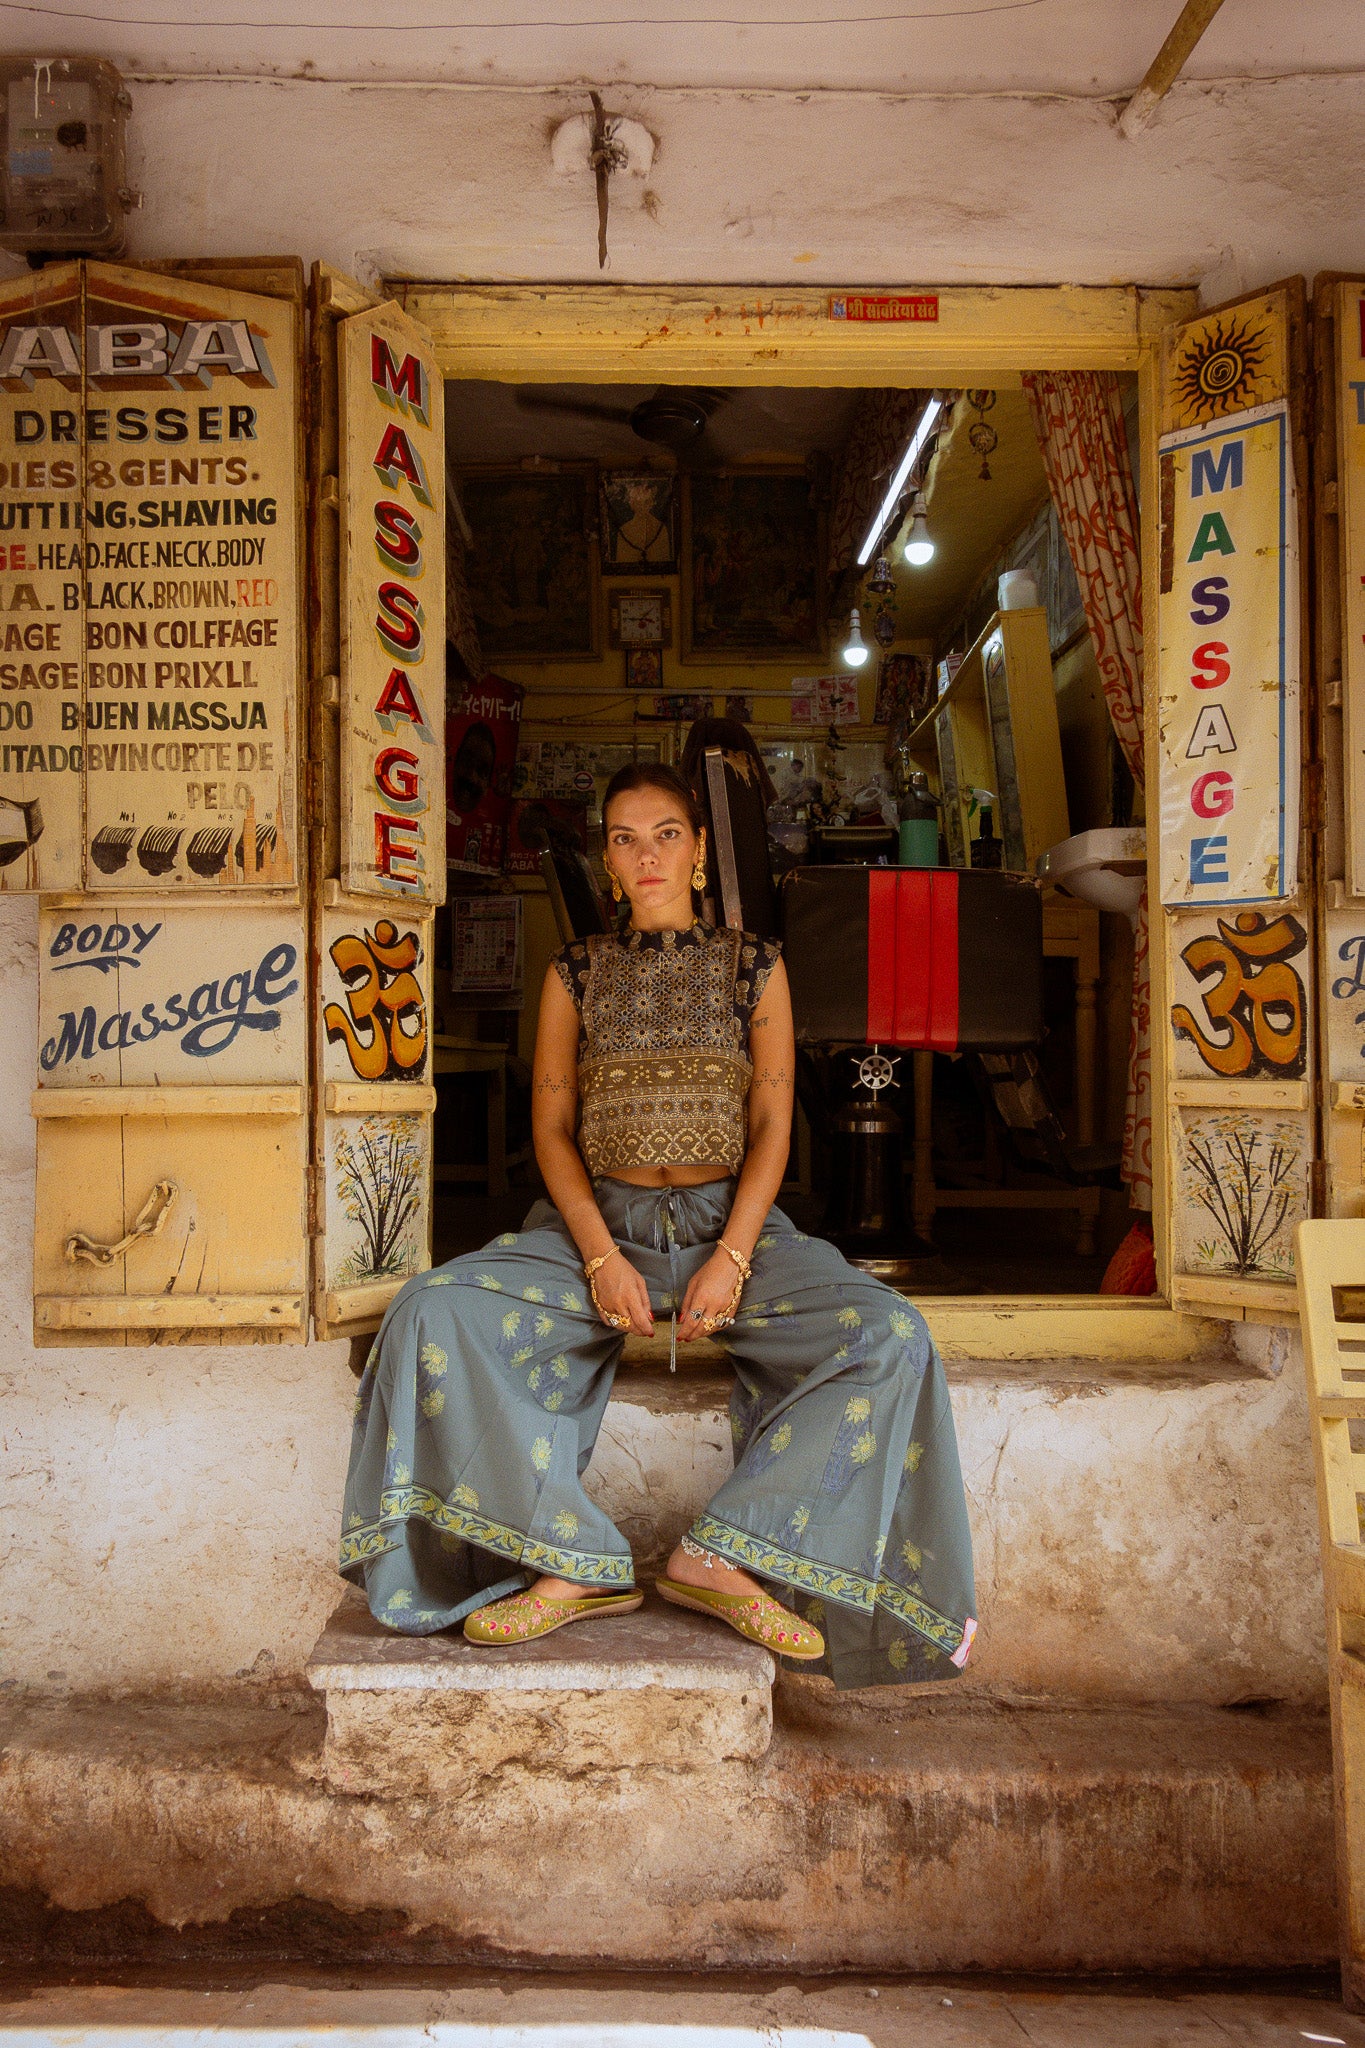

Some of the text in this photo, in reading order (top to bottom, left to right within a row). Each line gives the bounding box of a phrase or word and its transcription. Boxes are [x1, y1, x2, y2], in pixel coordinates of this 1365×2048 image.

[14, 405, 257, 444] DRESSER
[370, 331, 426, 888] MASSAGE
[0, 618, 279, 651] AGE BON COLFFAGE
[89, 661, 148, 689] BON
[155, 660, 258, 689] PRIXLL
[1186, 440, 1244, 886] MASSAGE
[61, 701, 138, 731] BUEN
[186, 781, 252, 811] PELO
[50, 922, 163, 958] BODY
[40, 942, 300, 1072] Massage
